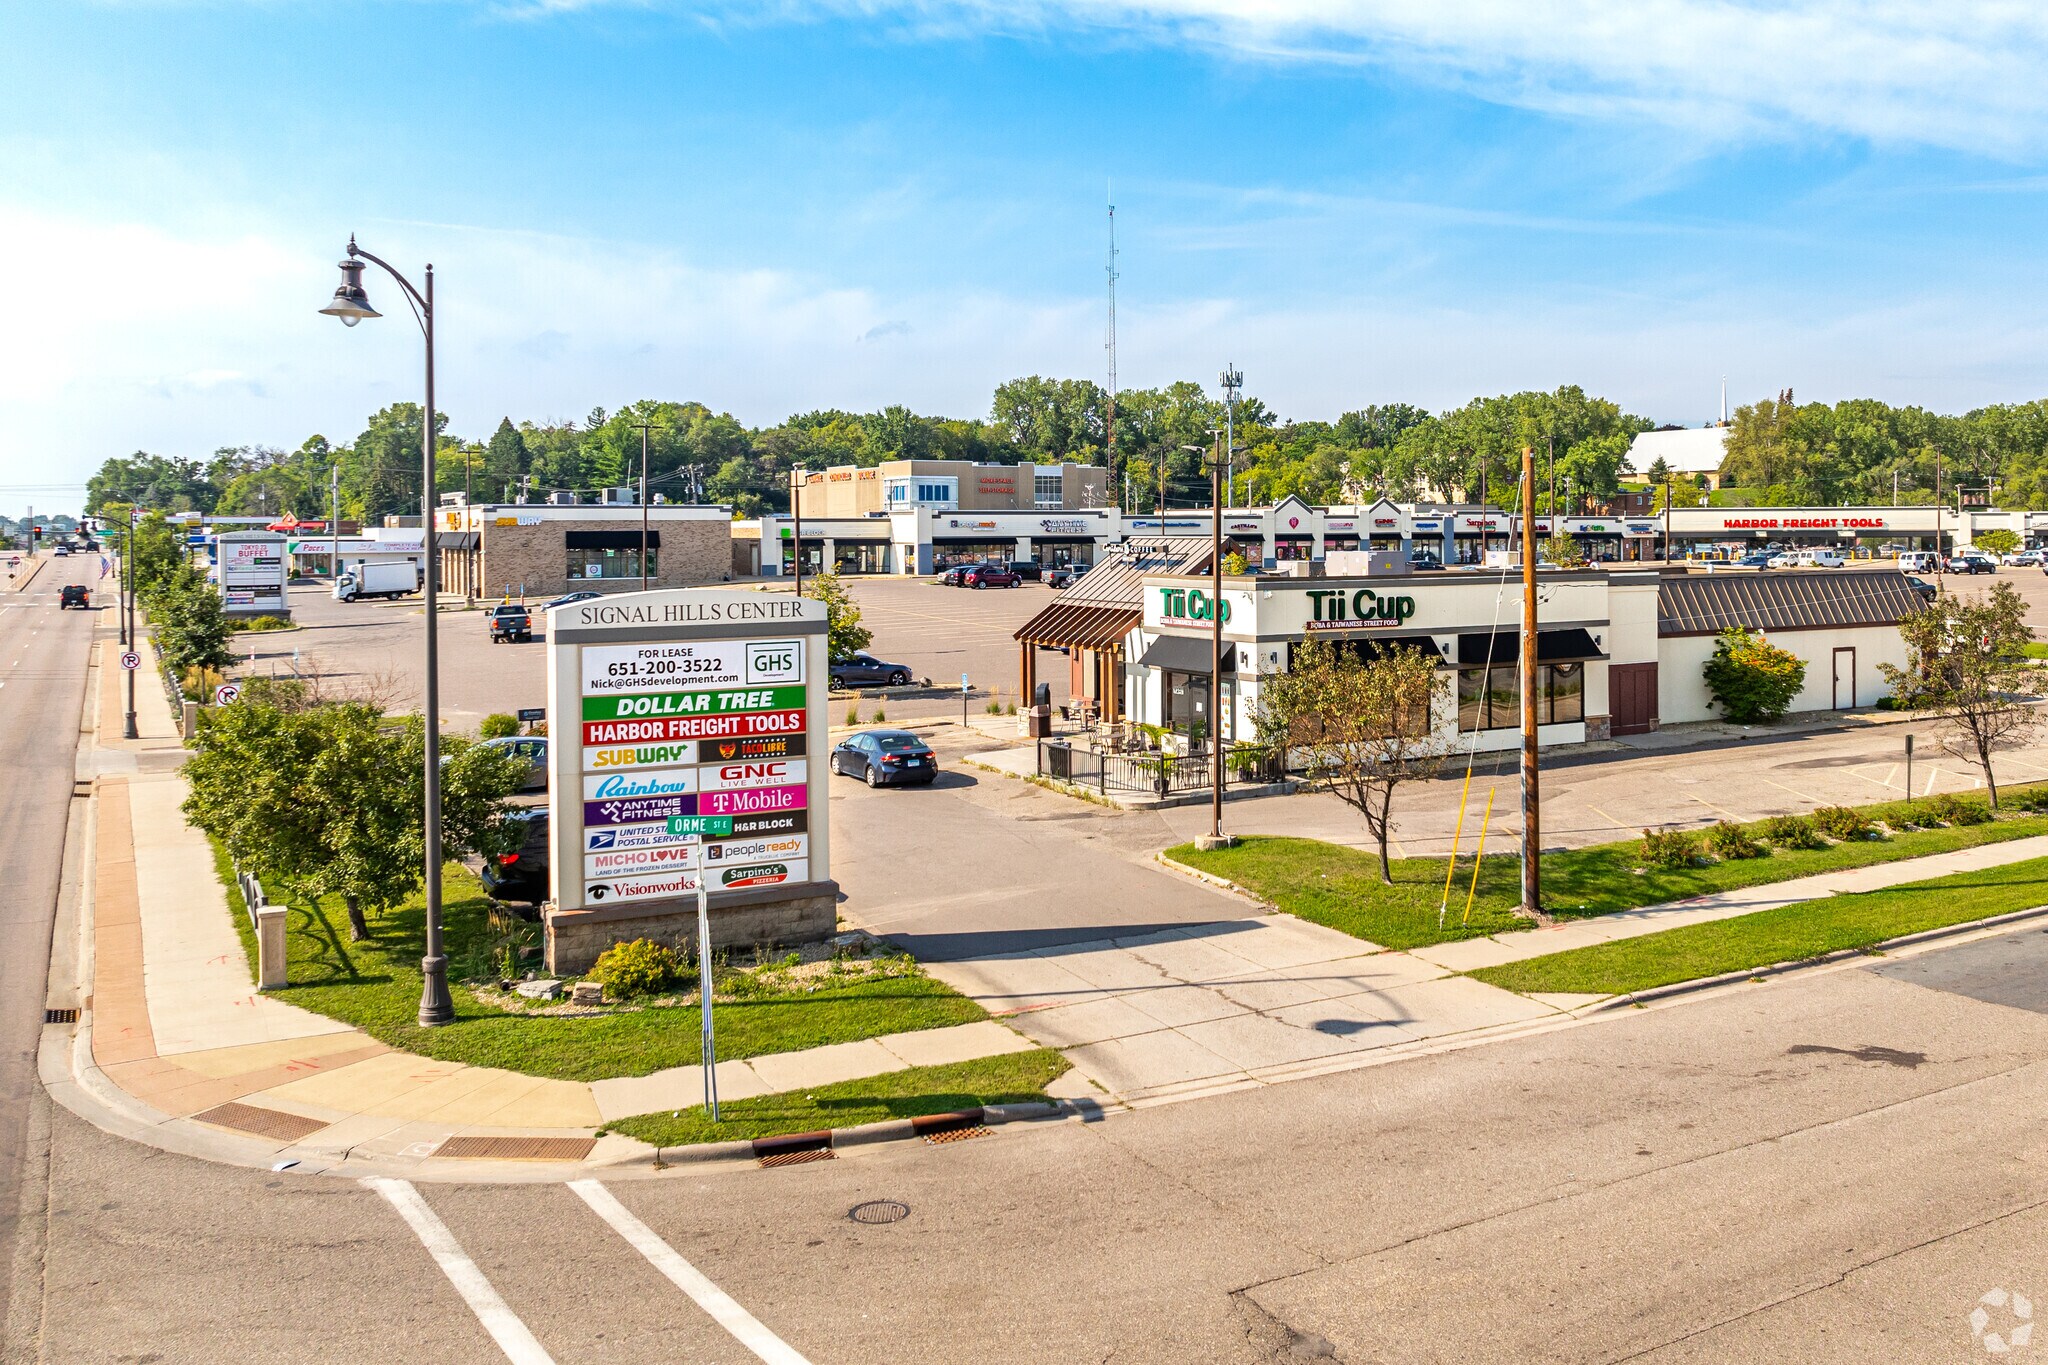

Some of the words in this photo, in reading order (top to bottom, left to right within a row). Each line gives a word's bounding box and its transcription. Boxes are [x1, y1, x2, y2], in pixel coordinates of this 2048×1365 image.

[496, 516, 542, 527] SUBWAY
[1724, 519, 1778, 528] HARBOR
[1783, 518, 1838, 528] FREIGHT
[1842, 518, 1883, 528] TOOLS
[1160, 588, 1185, 618] Tii
[1306, 590, 1345, 620] Tii
[1353, 590, 1415, 626] Cup
[582, 605, 658, 624] SIGNAL
[664, 602, 722, 622] HILLS
[727, 601, 804, 620] CENTER
[1332, 620, 1363, 628] TAIWANESE
[638, 650, 660, 658] FOR
[662, 648, 693, 658] LEASE
[608, 658, 722, 676] 651-200-3522
[754, 654, 793, 672] GHS
[591, 673, 739, 690] Nick@GHSdevelopment.com
[617, 694, 711, 716] DOLLAR
[717, 691, 774, 710] TREE
[590, 719, 664, 743] HARBOR
[668, 716, 741, 738] FREIGHT
[746, 713, 800, 730] TOOLS
[593, 744, 688, 768] SUBWAY
[720, 762, 786, 780] GNC
[596, 775, 686, 798] Rainbow
[720, 778, 747, 788] LIVE
[755, 776, 786, 786] WELL
[622, 798, 681, 810] ANYTIME
[733, 791, 792, 810] Mobile
[622, 807, 682, 819] FITNESS
[620, 827, 653, 836] UNITED
[654, 826, 668, 834] STA
[675, 818, 706, 832] ORME
[713, 820, 721, 829] ST
[723, 820, 727, 829] E
[734, 822, 757, 832] H&R
[759, 818, 793, 830] BLOCK
[617, 836, 650, 846] POSTAL
[652, 834, 688, 845] SERVICE
[595, 852, 647, 868] MICHO
[636, 865, 660, 873] FROZEN
[661, 862, 688, 870] DESSERT
[731, 866, 779, 879] Sarpino's
[614, 876, 695, 897] Visionworks
